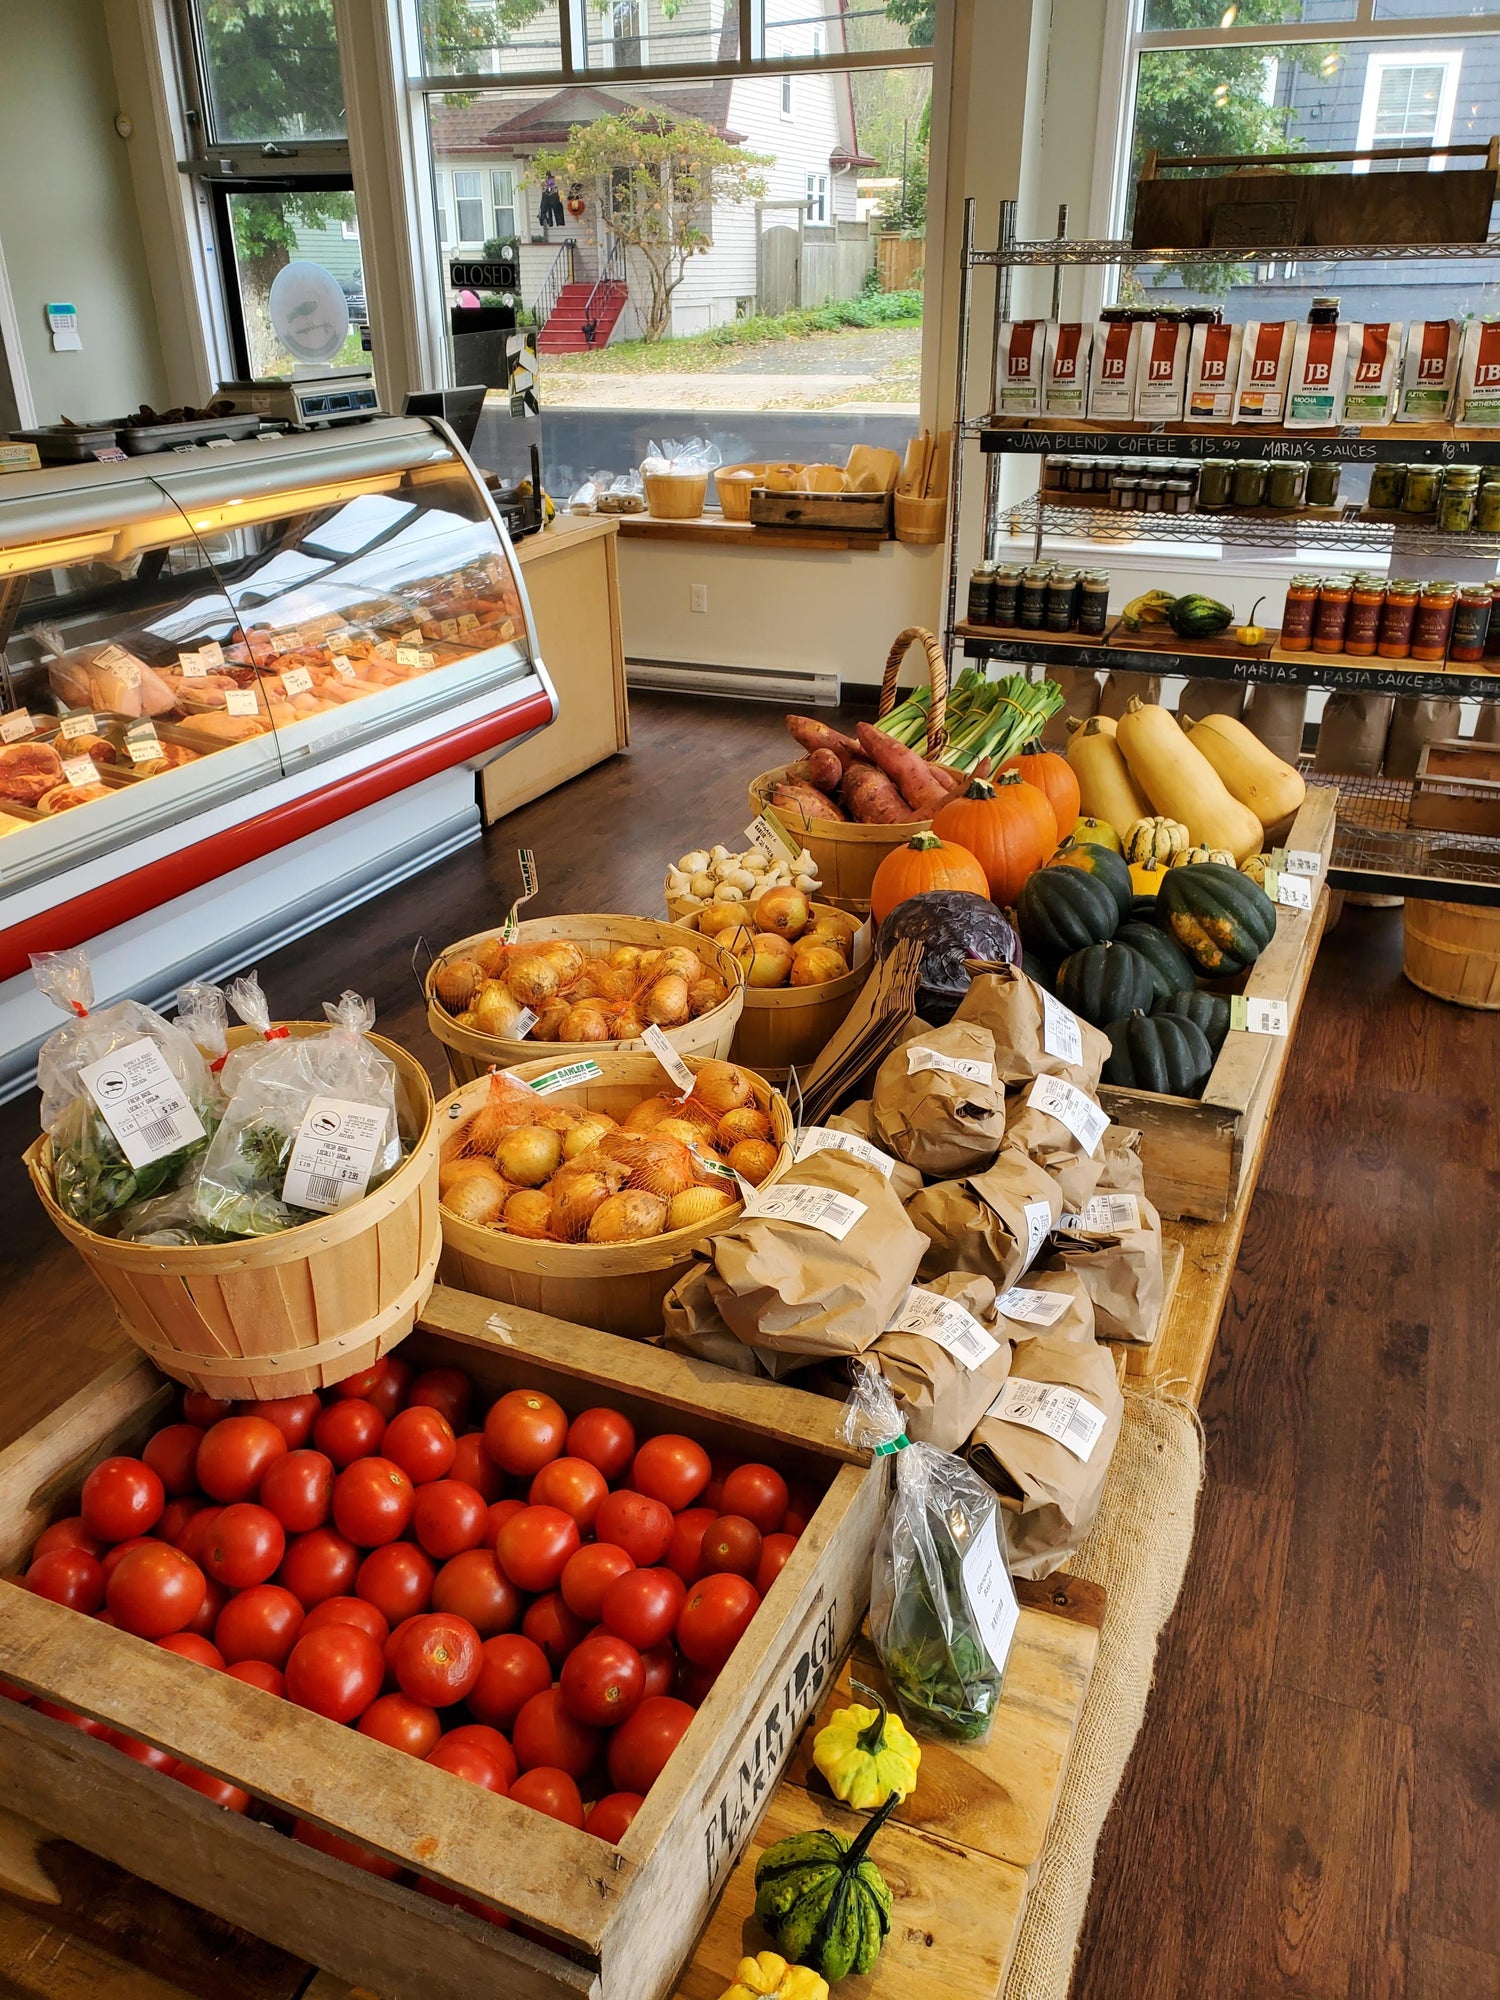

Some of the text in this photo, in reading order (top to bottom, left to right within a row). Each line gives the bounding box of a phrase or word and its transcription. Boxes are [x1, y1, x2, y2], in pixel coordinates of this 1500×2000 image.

[452, 264, 513, 286] CLOSED
[1010, 357, 1029, 375] JB
[1056, 358, 1075, 378] JB
[1104, 358, 1124, 378] JB
[1151, 360, 1172, 379] JB
[1203, 360, 1225, 380] JB
[1253, 360, 1277, 379] JB
[1306, 363, 1329, 383] JB
[1358, 362, 1382, 382] JB
[1420, 358, 1444, 378] JB
[1477, 364, 1500, 386] JB
[1014, 434, 1051, 449] JAVA
[1055, 435, 1108, 449] BLEND
[1118, 436, 1177, 452] COFFEE
[1261, 441, 1316, 458] MARIA'S
[1321, 444, 1377, 458] SAUCES
[1322, 670, 1372, 684] PASTA
[1377, 672, 1425, 688] SAUCE
[557, 1064, 587, 1078] SAWLER
[127, 1094, 140, 1104] FRESH
[127, 1094, 160, 1113] LOCALLY GROWN
[169, 1100, 179, 1111] 2.99
[316, 1149, 351, 1161] LOCALLY GROWN
[323, 1143, 336, 1151] FRESH
[348, 1171, 359, 1180] 2.99
[790, 1663, 824, 1734] LTD
